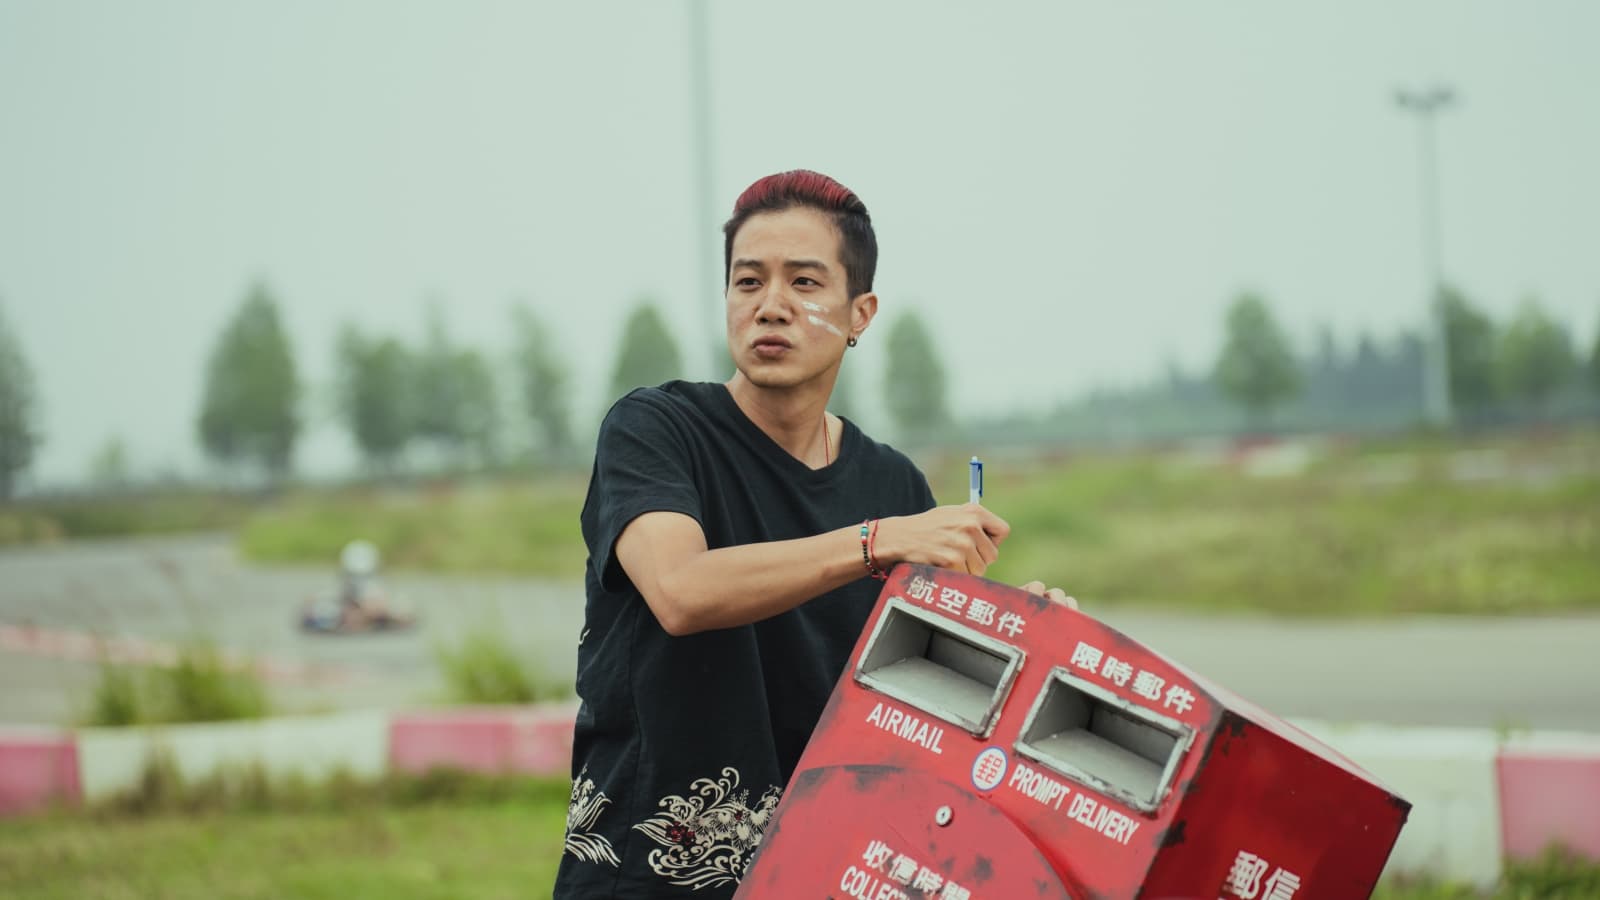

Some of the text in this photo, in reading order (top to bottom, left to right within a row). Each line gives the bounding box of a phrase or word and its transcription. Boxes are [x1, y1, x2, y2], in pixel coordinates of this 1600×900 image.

[906, 575, 1026, 637] 航空郵件
[1070, 641, 1195, 714] 限時郵件
[865, 702, 944, 754] AIRMAIL
[1008, 764, 1140, 845] PROMPT DELIVERY
